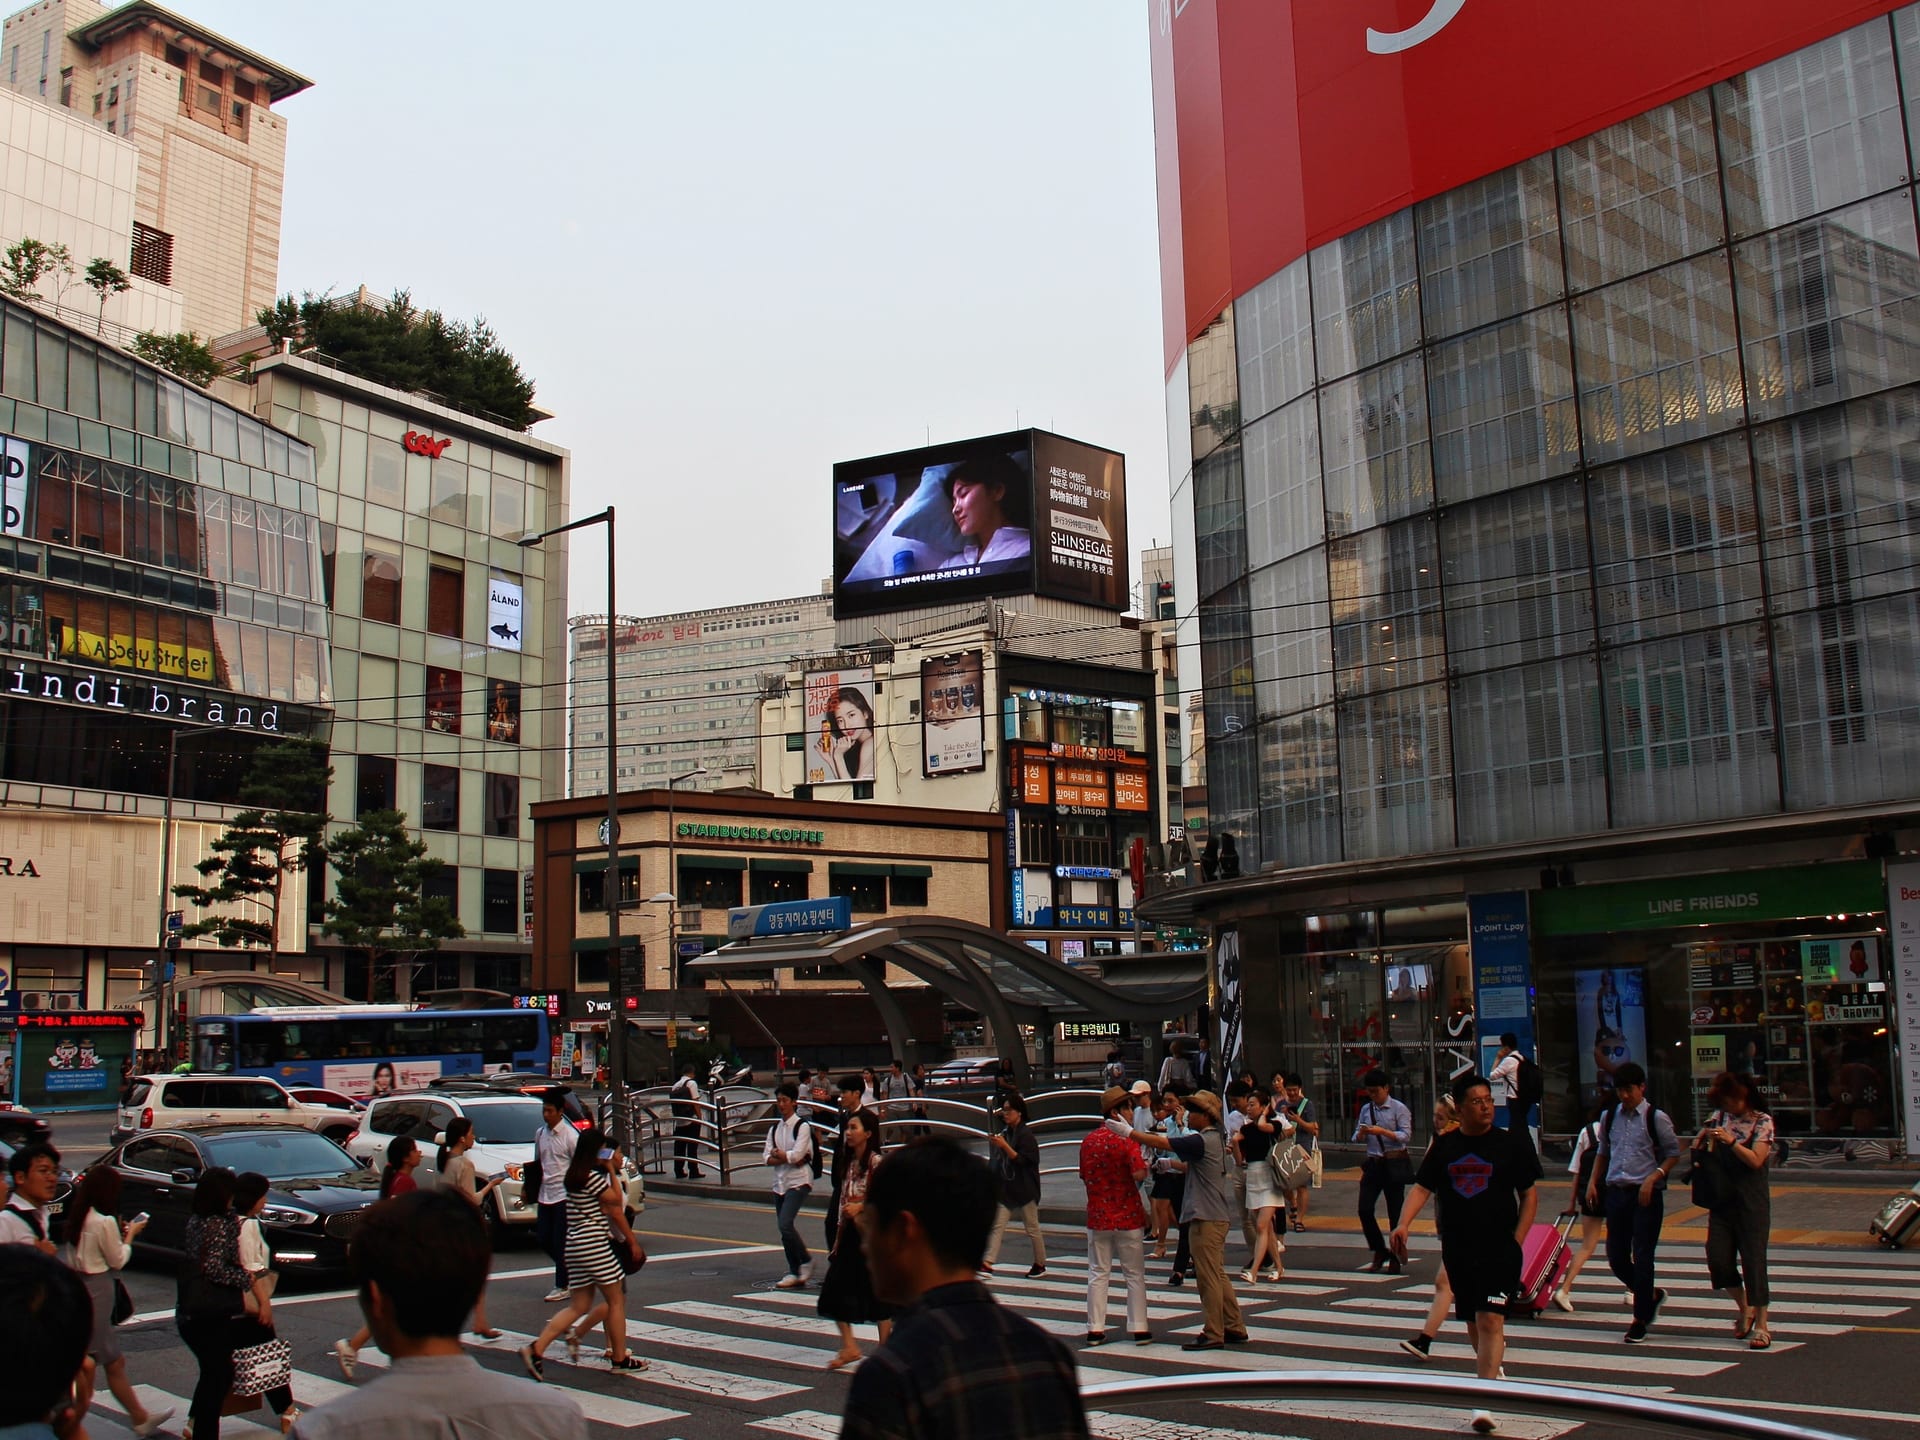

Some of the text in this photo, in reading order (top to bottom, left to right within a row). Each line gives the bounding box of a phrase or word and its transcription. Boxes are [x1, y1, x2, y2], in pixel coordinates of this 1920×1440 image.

[1051, 531, 1113, 558] SHINSEGAE
[155, 646, 208, 674] Street
[10, 664, 278, 732] indi brand
[1071, 805, 1107, 817] Skinspa
[677, 822, 825, 844] STARBUCKS COFFEE
[1648, 893, 1759, 914] LINE FRIENDS
[1842, 994, 1878, 1005] BEAT
[1843, 1007, 1880, 1018] BROWN
[1757, 1085, 1780, 1094] TORE
